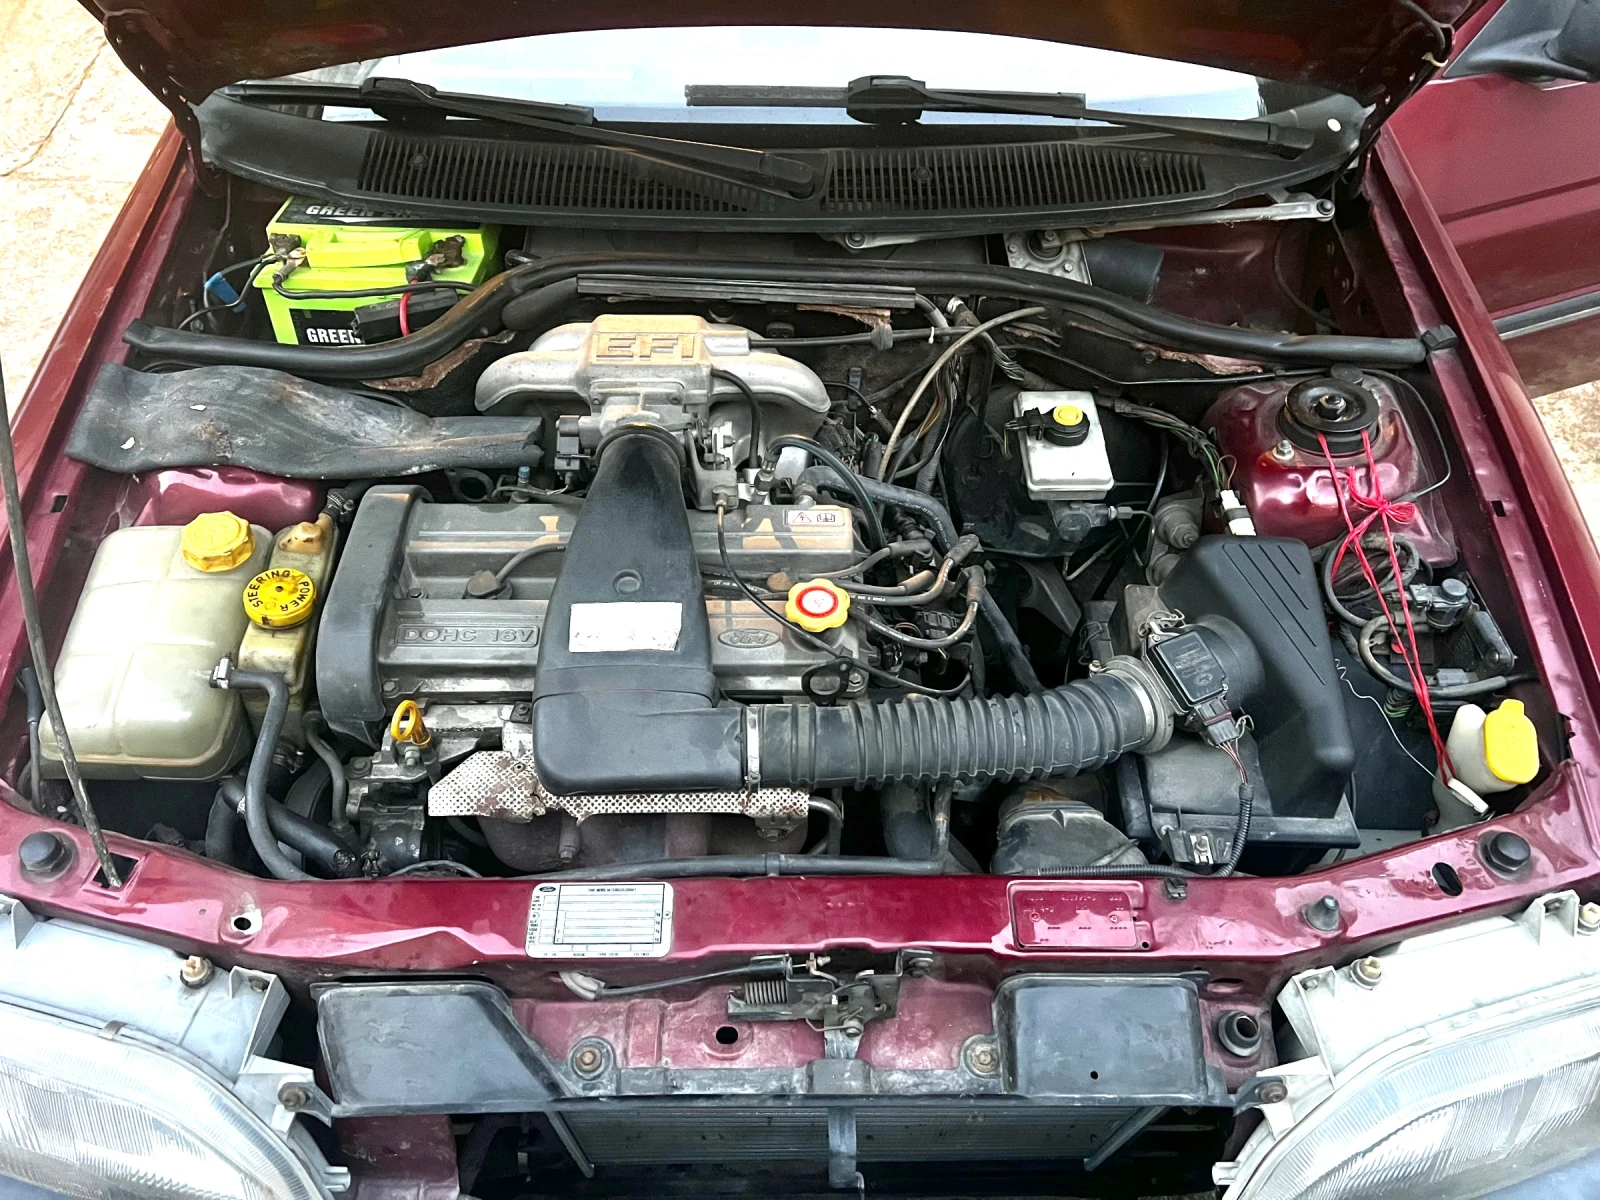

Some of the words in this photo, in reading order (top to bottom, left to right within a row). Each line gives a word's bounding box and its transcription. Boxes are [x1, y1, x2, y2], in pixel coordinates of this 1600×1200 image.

[596, 333, 696, 359] EFI
[280, 581, 310, 612] POWER
[403, 628, 477, 643] DOHC
[491, 628, 535, 643] 16V
